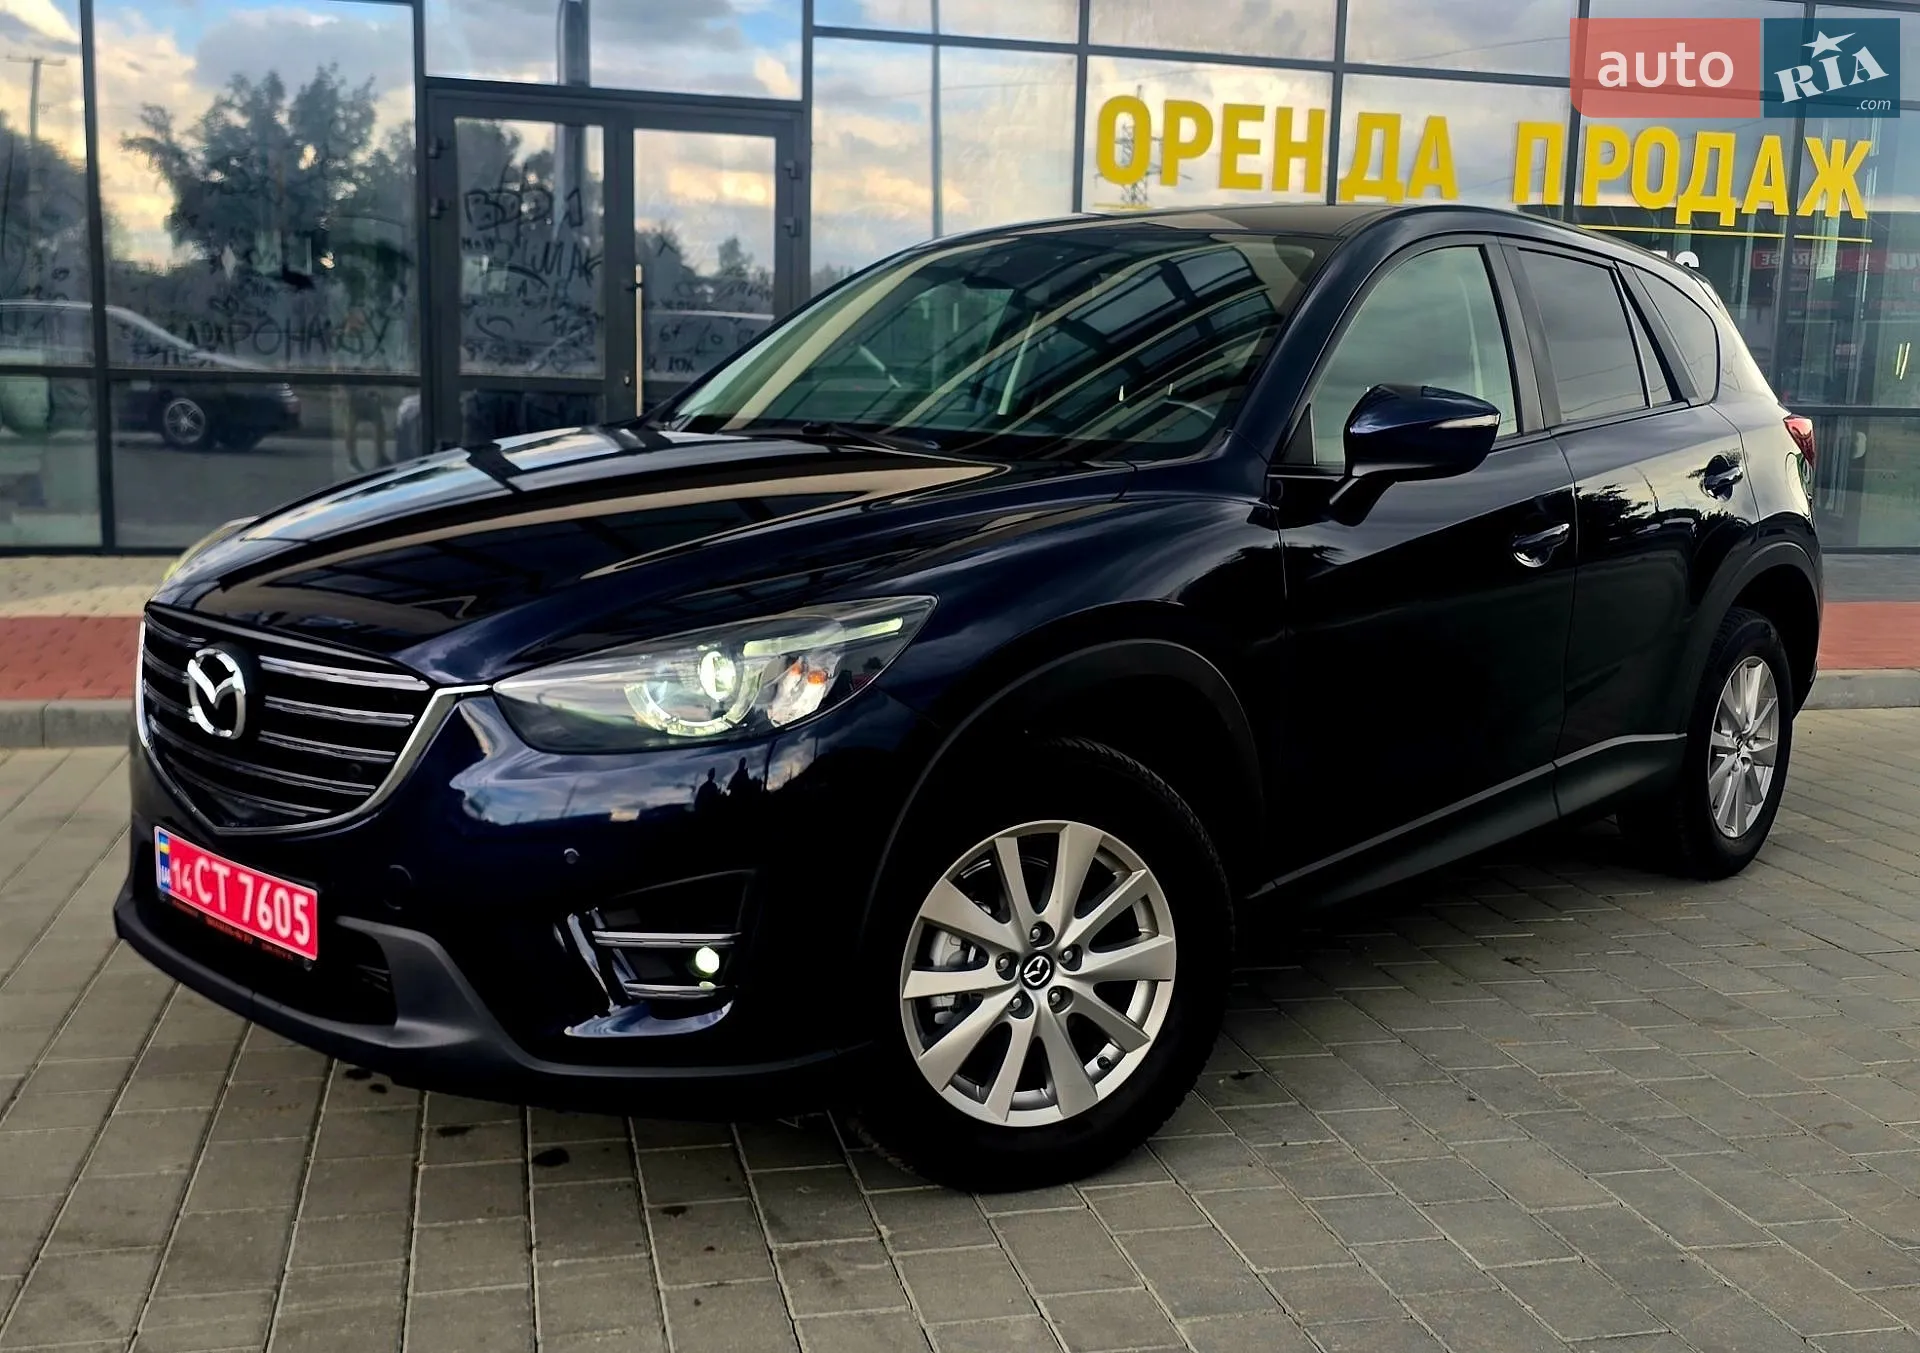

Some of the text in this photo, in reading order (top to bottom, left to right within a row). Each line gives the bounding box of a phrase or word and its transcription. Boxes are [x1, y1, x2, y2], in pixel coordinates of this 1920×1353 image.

[1096, 95, 1873, 226] ОРЕНДА ПРОДАЖ
[237, 874, 311, 946] 7605
